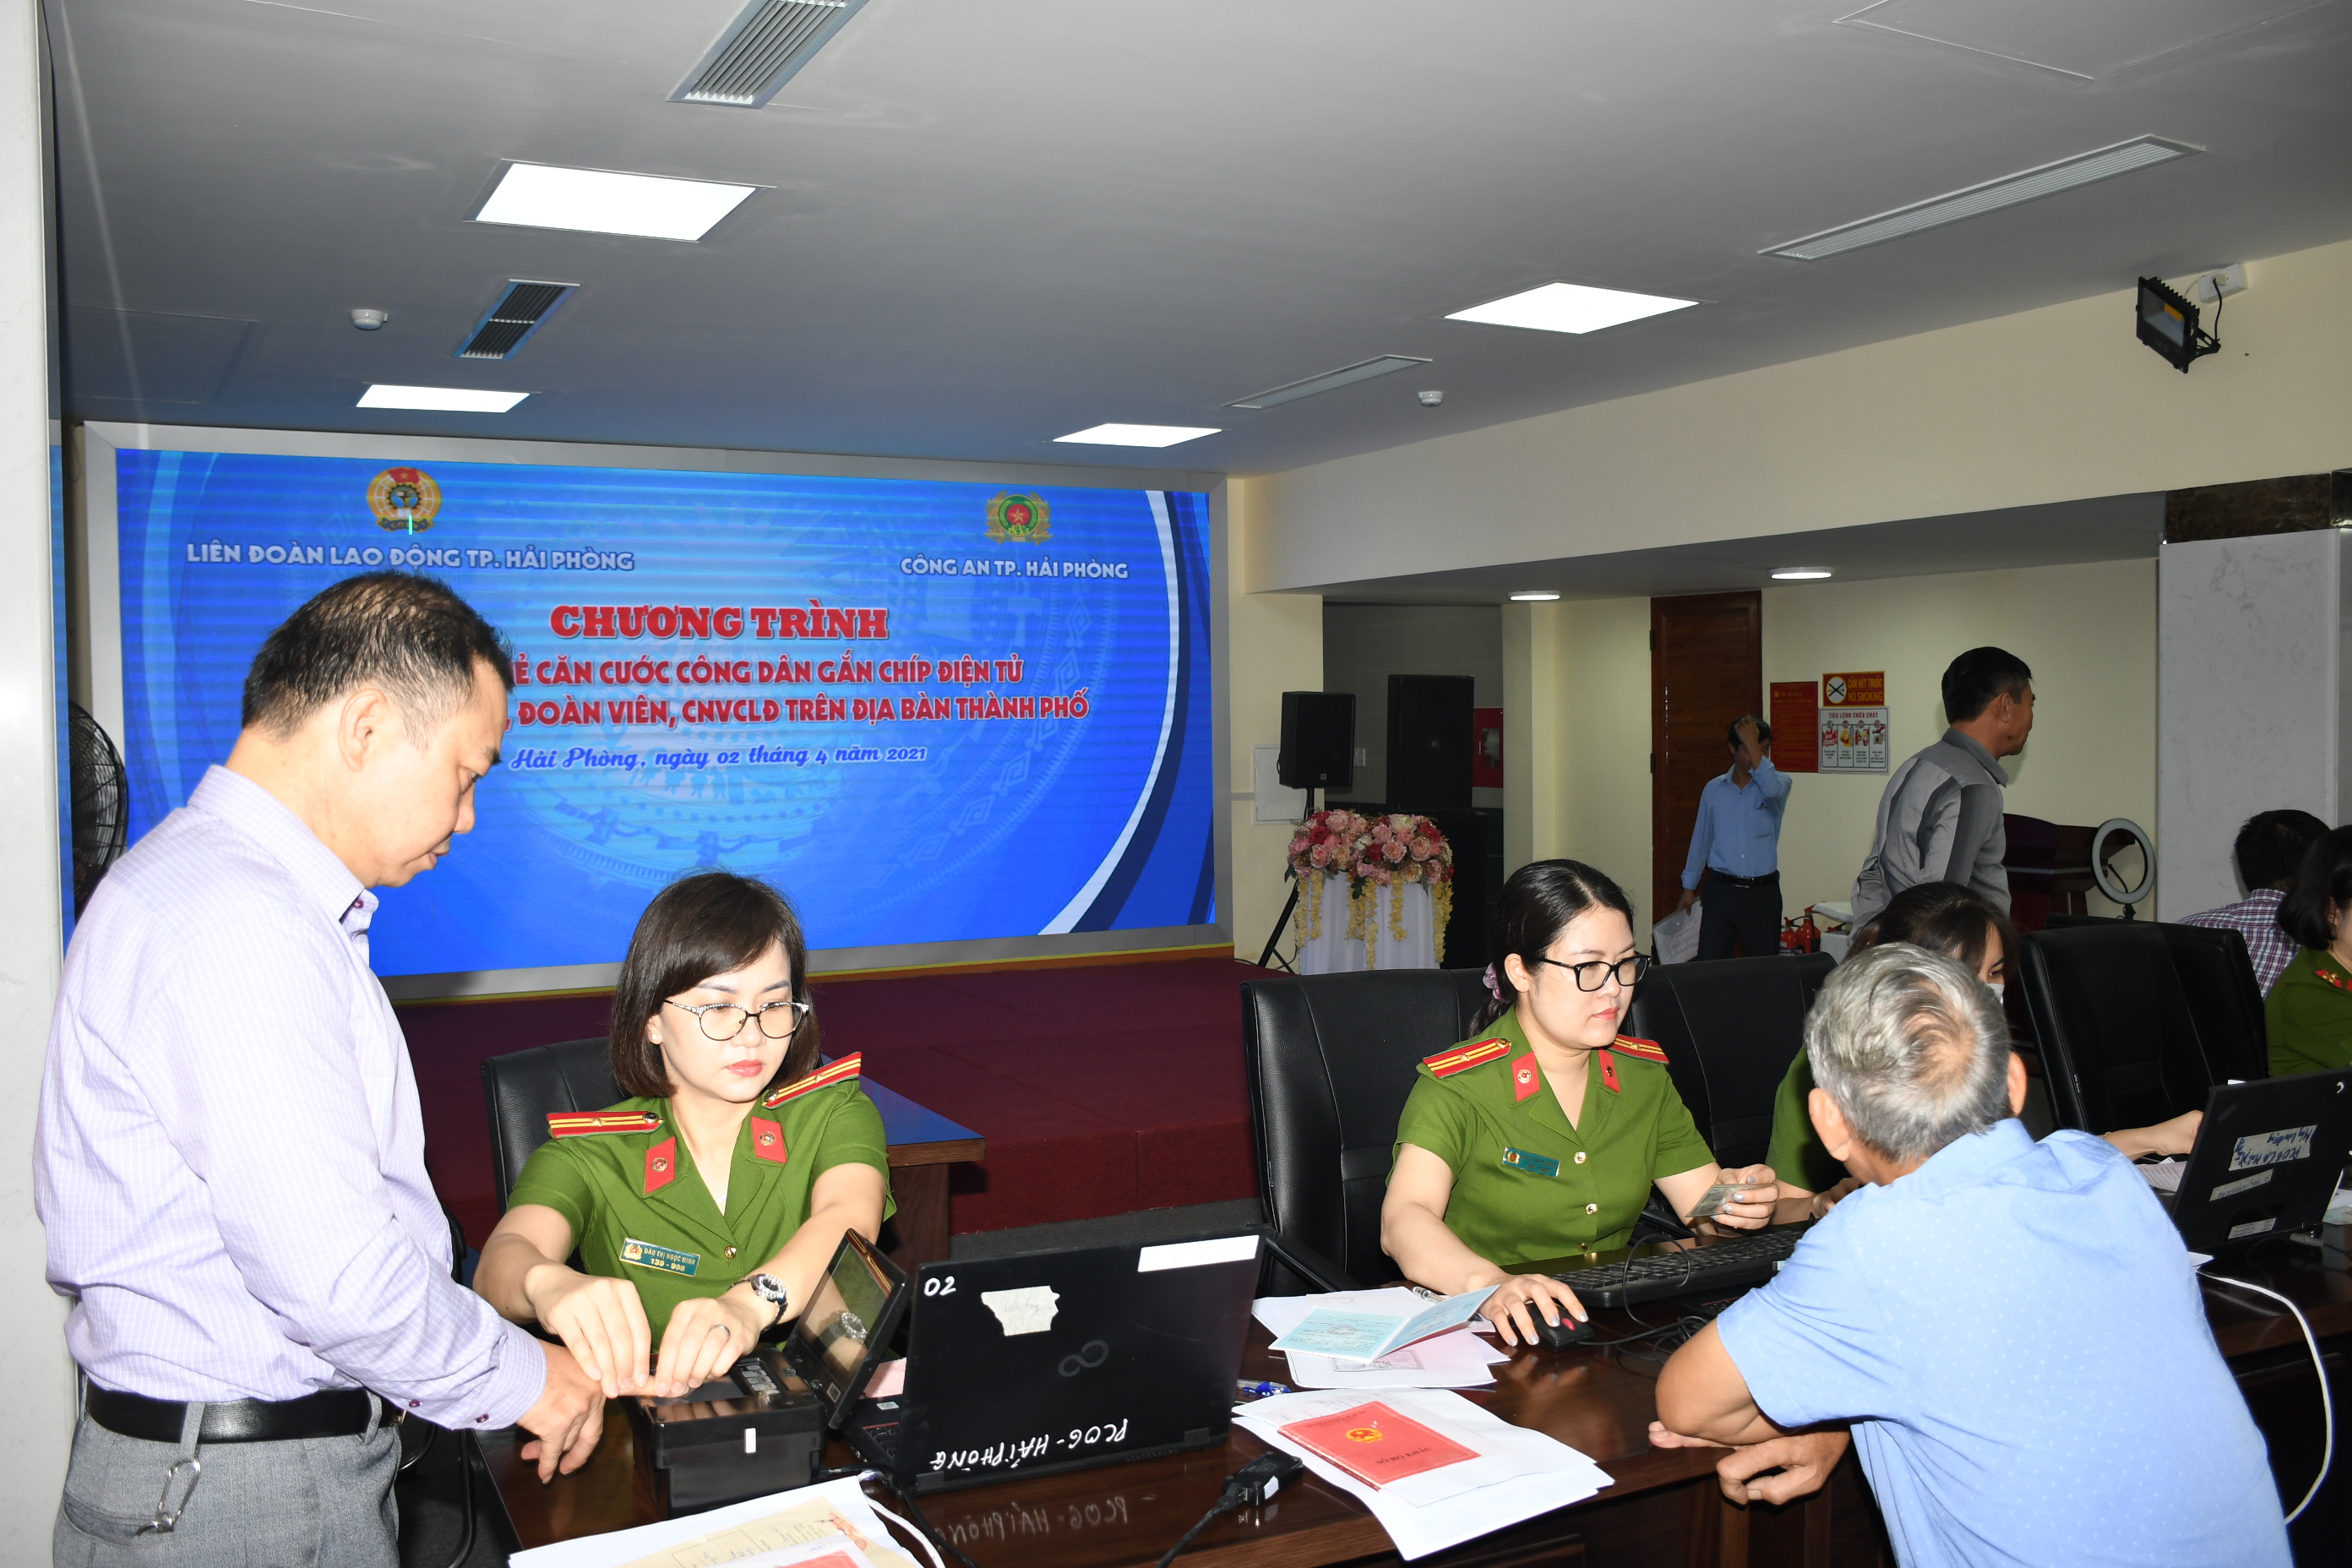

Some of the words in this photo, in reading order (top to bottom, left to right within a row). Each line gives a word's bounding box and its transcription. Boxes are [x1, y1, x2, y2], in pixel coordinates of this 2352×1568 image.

[187, 539, 242, 564] LIÊN
[248, 541, 325, 565] ĐOÀN
[329, 547, 384, 567] LAO
[389, 545, 461, 570] ĐỘNG
[466, 549, 501, 568] TP.
[505, 545, 547, 569] HẢI
[551, 547, 634, 571] PHÒNG
[901, 553, 958, 576] CÔNG
[961, 558, 990, 576] AN
[994, 559, 1022, 577] TP.
[1026, 556, 1059, 578] HẢI
[1063, 558, 1129, 580] PHÒNG
[550, 604, 743, 639] CHƯƠNG
[749, 598, 889, 639] TRÌNH
[536, 654, 593, 685] CĂN
[599, 654, 671, 685] CƯỚC
[675, 654, 752, 684] CÔNG
[758, 654, 812, 683] DÂN
[817, 650, 874, 683] GẮN
[878, 654, 933, 683] CHÍP
[937, 654, 990, 688] ĐIỆN
[994, 653, 1024, 683] TỬ
[518, 694, 602, 725] ĐOÀN
[607, 694, 677, 728] VIÊN,
[681, 699, 781, 723] CNVCLĐ
[785, 693, 846, 722] TRÊN
[852, 698, 896, 726] ĐỊA
[900, 691, 951, 721] BÀN
[956, 690, 1035, 720] THÀNH
[1039, 688, 1089, 719] PHỐ
[1848, 691, 1857, 701] NO
[1858, 691, 1883, 702] SMOKING
[510, 747, 558, 769] Hải
[562, 747, 646, 771] Phòng,
[655, 748, 710, 770] ngày
[717, 751, 741, 764] 02
[749, 744, 810, 767] tháng
[814, 749, 828, 765] 4
[835, 746, 880, 762] năm
[886, 748, 927, 761] 2021
[651, 1258, 665, 1267] 139
[656, 1250, 666, 1260] THỊ
[682, 1257, 696, 1266] MINH
[923, 1276, 957, 1297] 02
